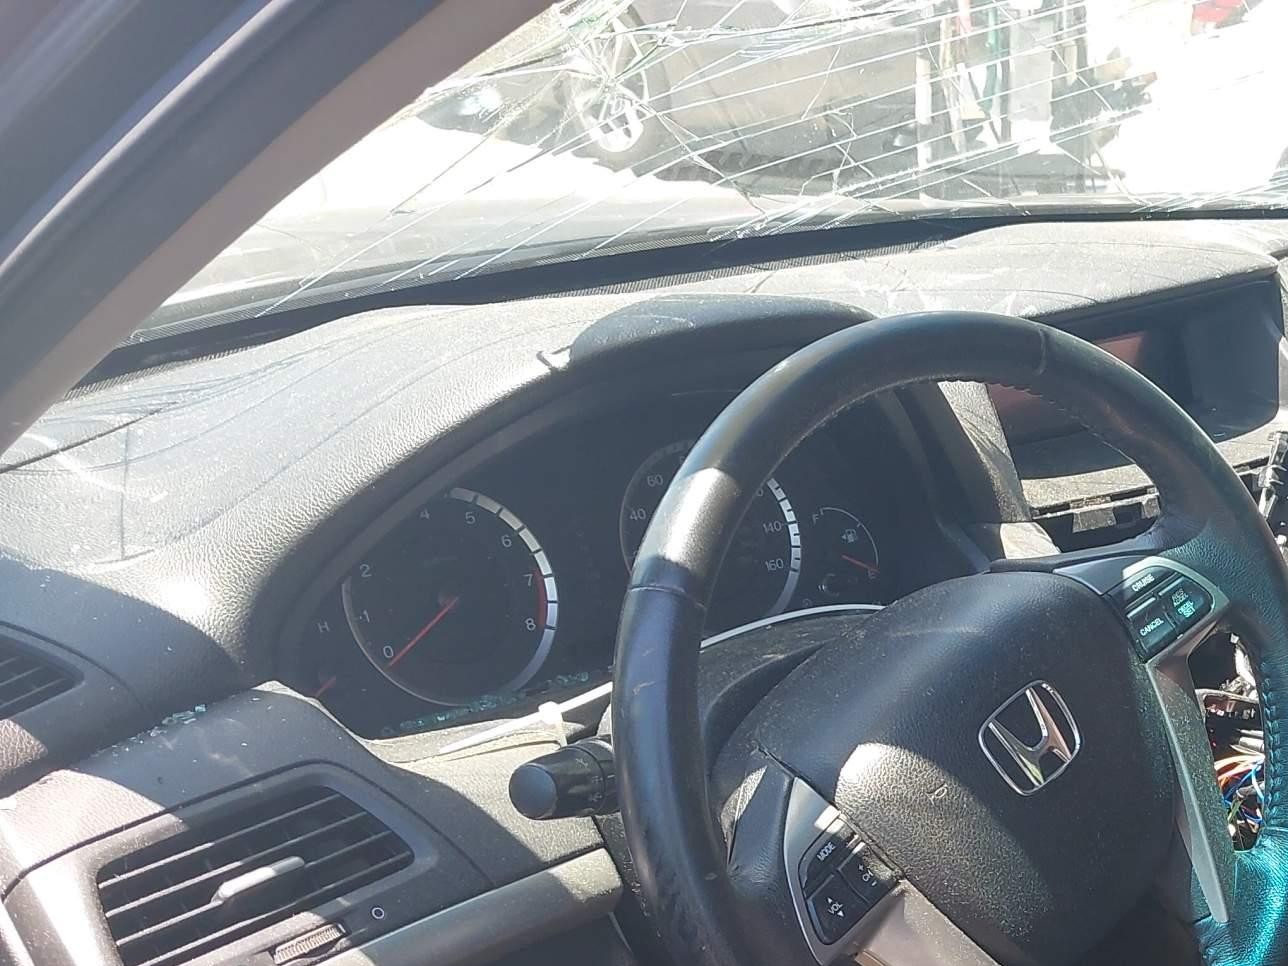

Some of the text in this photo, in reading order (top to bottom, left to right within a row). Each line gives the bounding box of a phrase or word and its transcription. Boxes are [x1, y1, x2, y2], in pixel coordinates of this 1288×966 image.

[465, 511, 476, 525] 5
[629, 508, 647, 520] 40
[763, 520, 782, 534] 140
[501, 535, 512, 548] 6
[360, 564, 372, 577] 2
[764, 558, 784, 572] 160
[523, 574, 534, 586] 7
[1132, 574, 1155, 591] CRUISE
[525, 618, 536, 631] 8
[1140, 618, 1164, 636] CANCEL
[383, 645, 395, 659] 0
[817, 841, 836, 861] MODE
[828, 902, 843, 915] VOL
